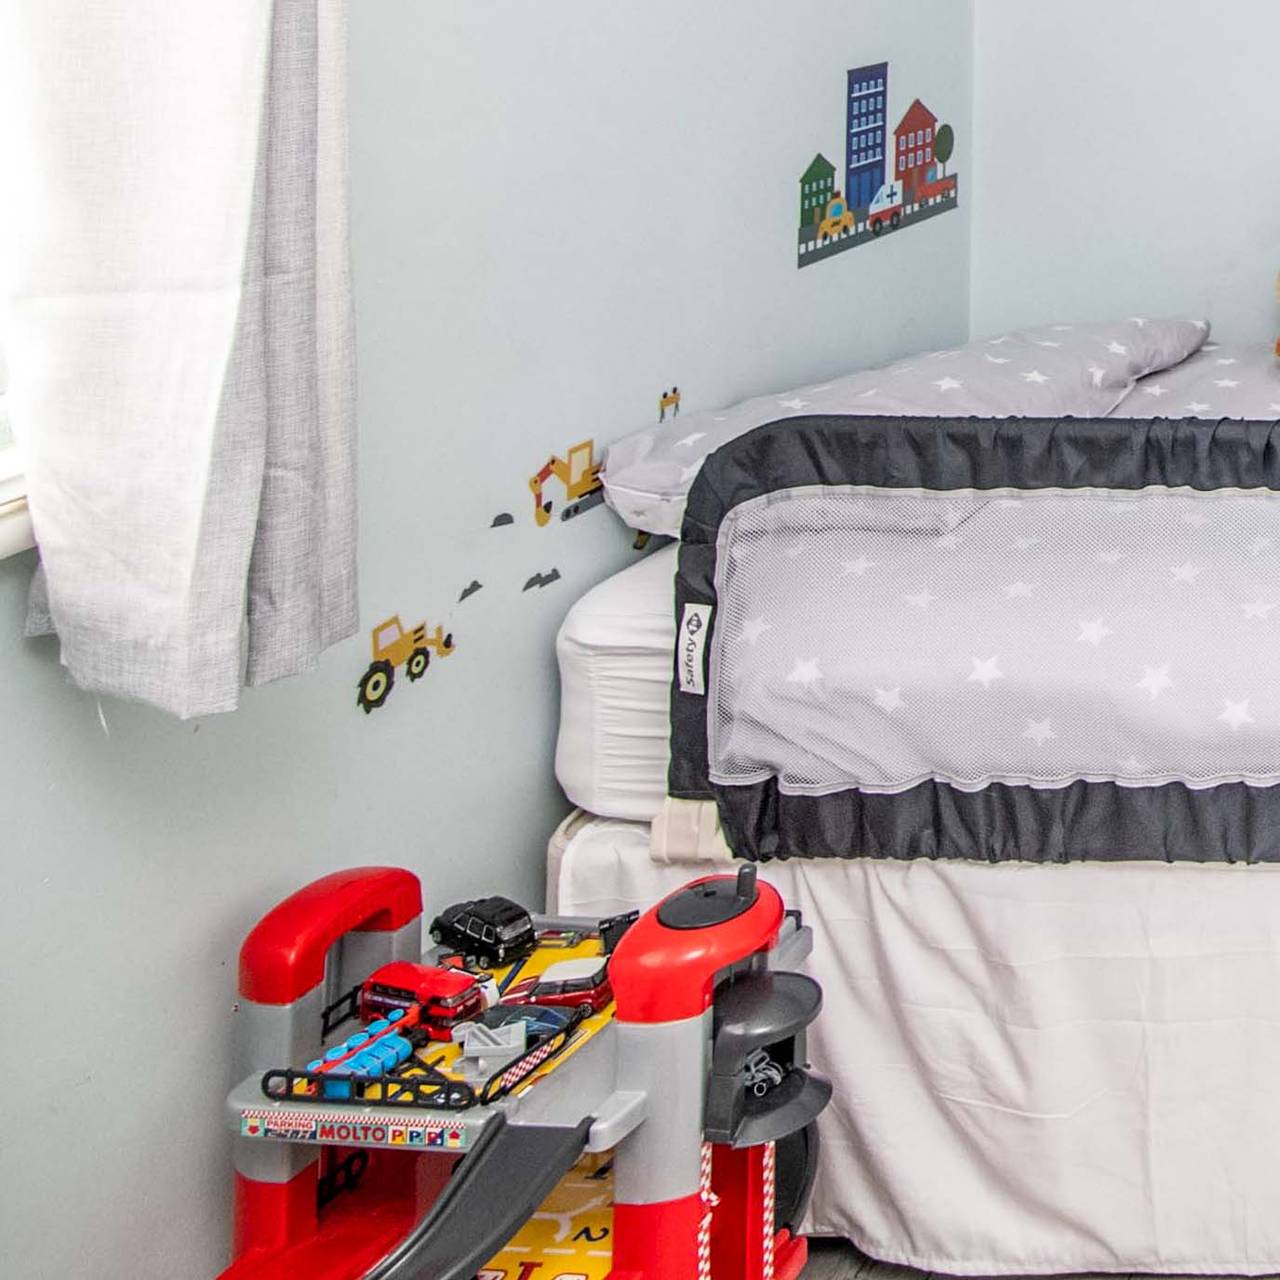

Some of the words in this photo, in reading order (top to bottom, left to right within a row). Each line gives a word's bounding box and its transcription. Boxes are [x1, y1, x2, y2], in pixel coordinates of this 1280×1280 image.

[685, 637, 697, 687] Safety
[266, 1120, 314, 1130] PARKING
[319, 1125, 386, 1142] MOLTO
[391, 1129, 404, 1142] P
[409, 1130, 421, 1142] P
